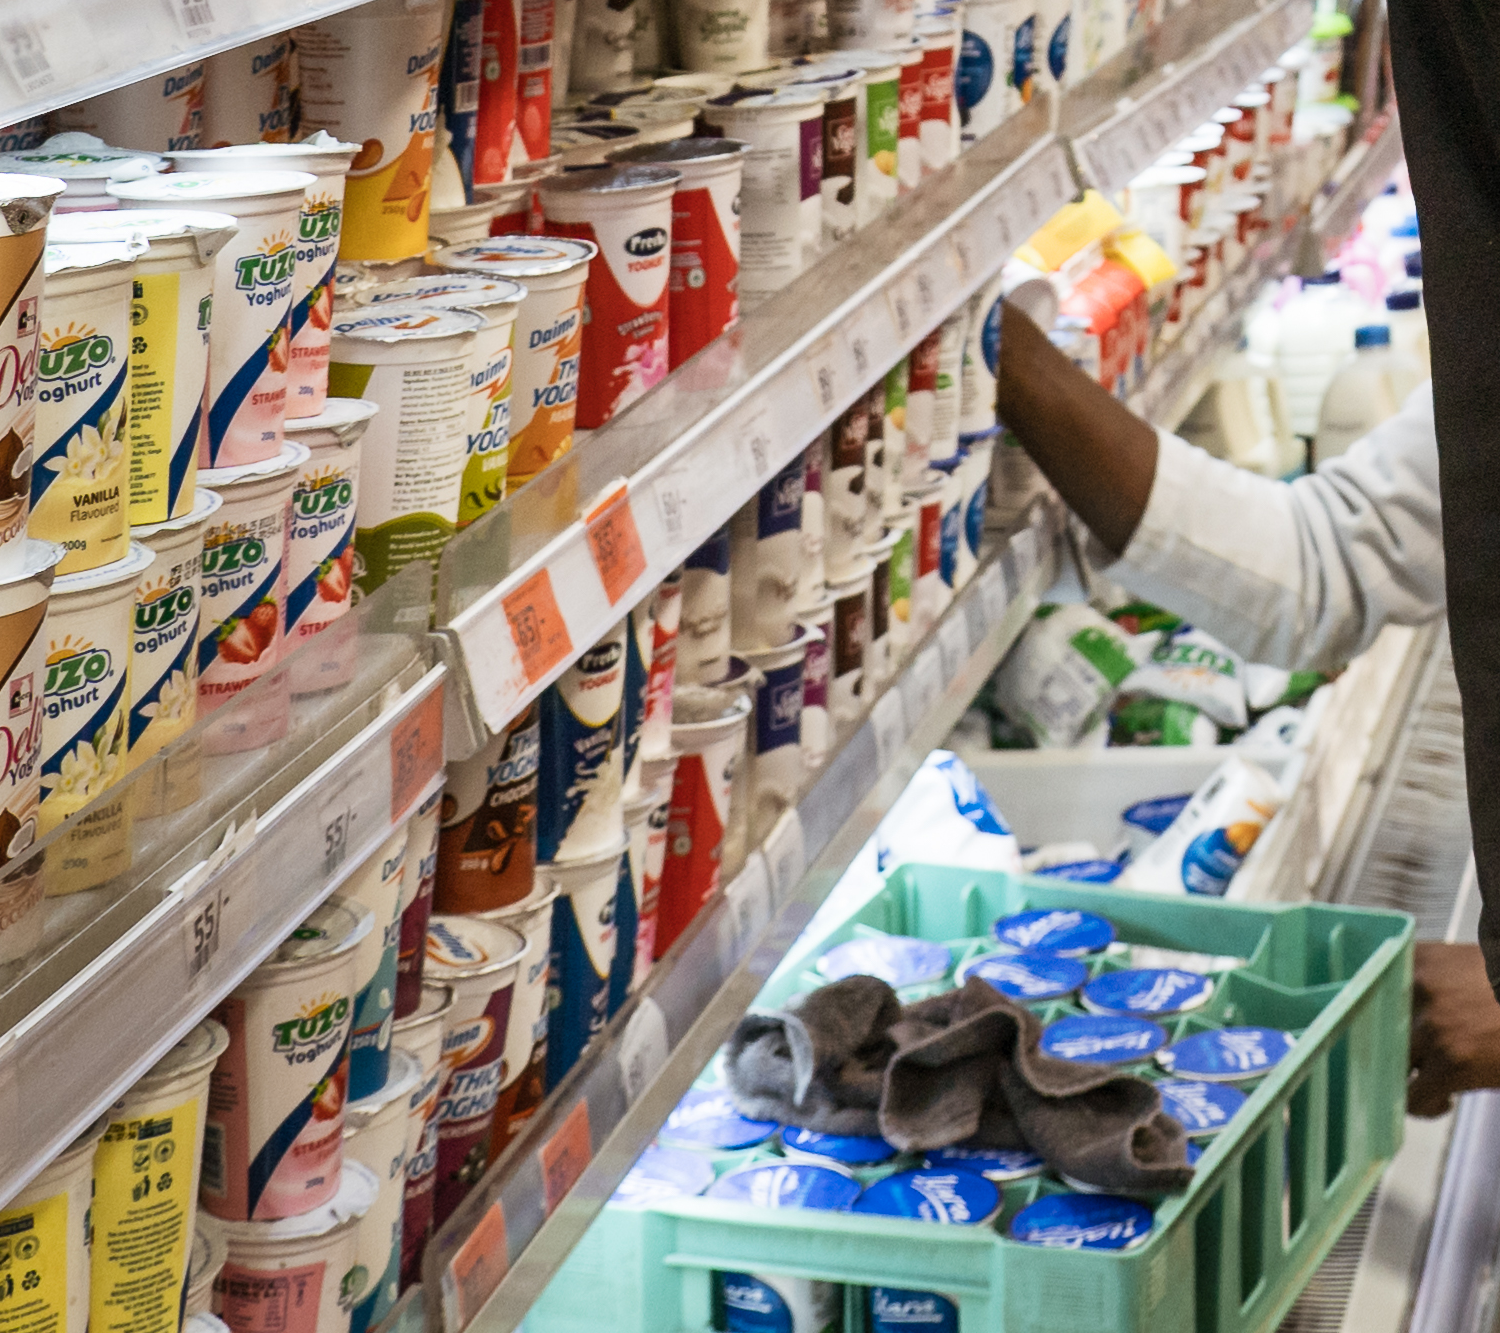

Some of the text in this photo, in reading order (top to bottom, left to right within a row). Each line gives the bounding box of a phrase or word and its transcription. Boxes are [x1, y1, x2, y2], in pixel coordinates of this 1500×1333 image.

[41, 334, 116, 381] UZO
[39, 373, 102, 403] oghurt
[69, 500, 120, 523] Flavoured
[73, 485, 120, 508] VANILLA
[133, 584, 196, 634] UZO
[133, 619, 188, 655] oghurt
